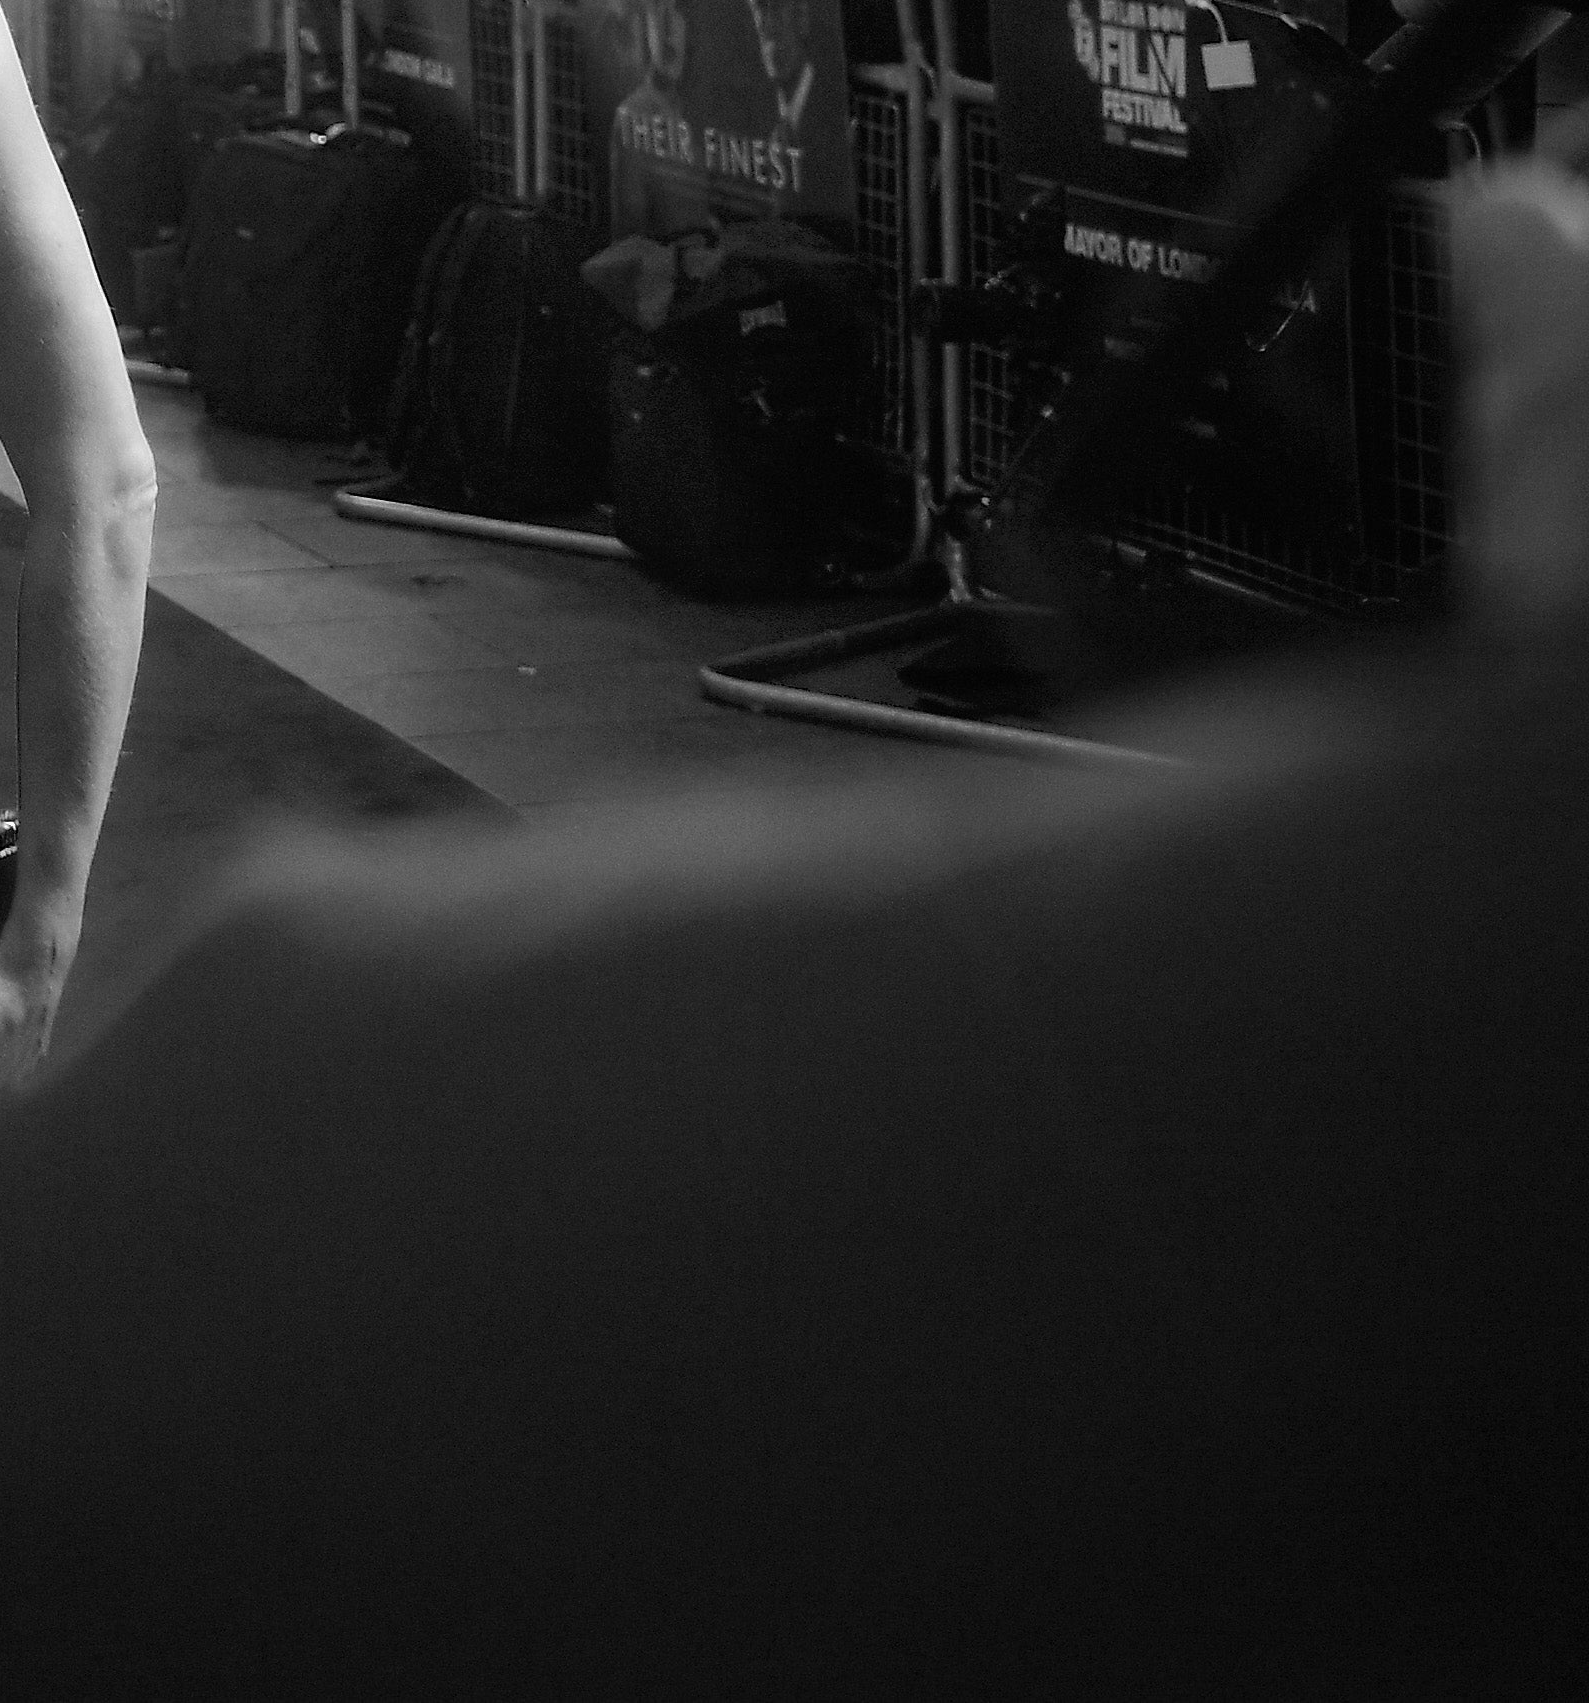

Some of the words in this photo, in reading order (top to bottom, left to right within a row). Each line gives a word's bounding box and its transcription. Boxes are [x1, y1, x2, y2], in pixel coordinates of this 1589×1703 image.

[1101, 25, 1187, 98] FILM
[1101, 89, 1189, 134] FESTIVAL
[617, 105, 695, 166] THEIR
[703, 126, 802, 193] FINEST
[1128, 237, 1152, 273] OF
